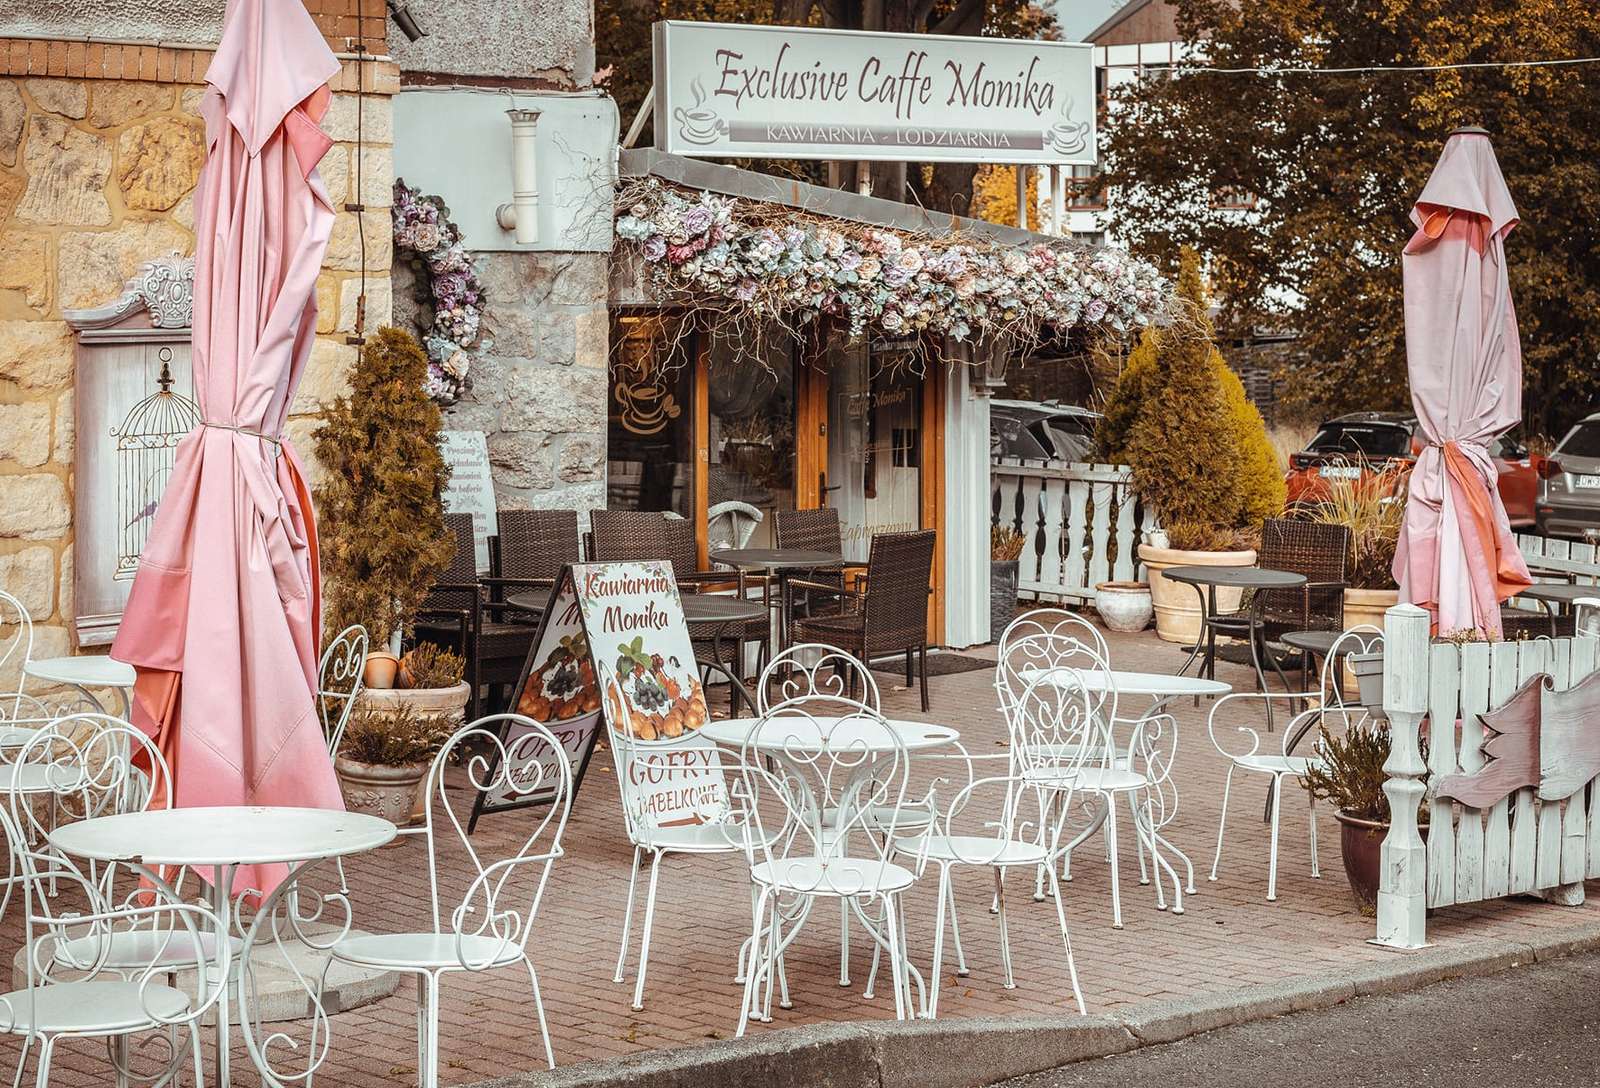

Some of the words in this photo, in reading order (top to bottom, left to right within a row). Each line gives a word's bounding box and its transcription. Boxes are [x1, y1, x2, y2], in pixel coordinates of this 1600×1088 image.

[714, 42, 849, 111] Exclusive
[858, 50, 932, 119] Caffe
[944, 56, 1054, 116] Monika
[767, 125, 875, 143] KAWIARNIA
[897, 128, 1011, 147] LODZIARNIA
[585, 571, 669, 600] Kawiarnia
[603, 600, 669, 634] Monika
[629, 750, 712, 786] GOFRY
